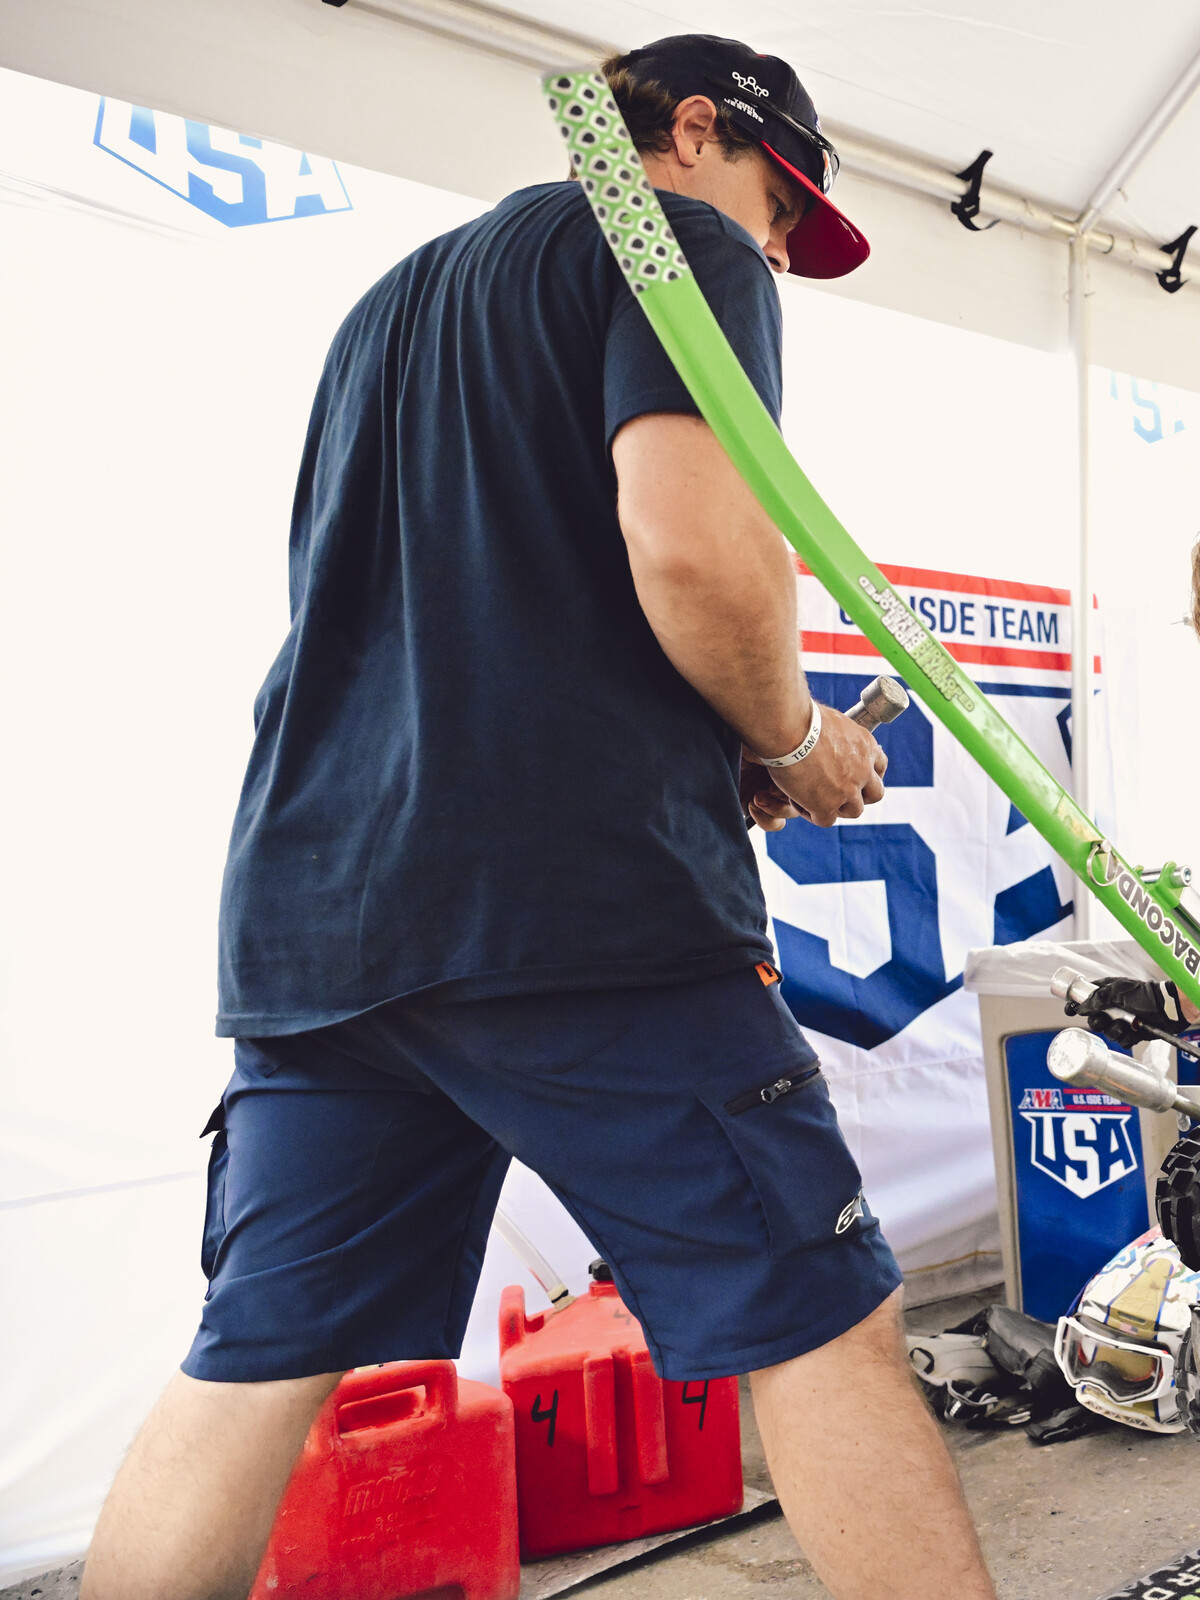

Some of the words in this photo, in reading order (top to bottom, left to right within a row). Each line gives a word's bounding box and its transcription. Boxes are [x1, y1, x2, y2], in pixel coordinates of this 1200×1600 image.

[984, 604, 1060, 645] TEAM
[791, 734, 817, 761] TEAM
[1018, 1088, 1065, 1110] AMA
[1031, 1113, 1137, 1198] USA
[531, 1389, 558, 1448] 4
[682, 1380, 709, 1431] 4
